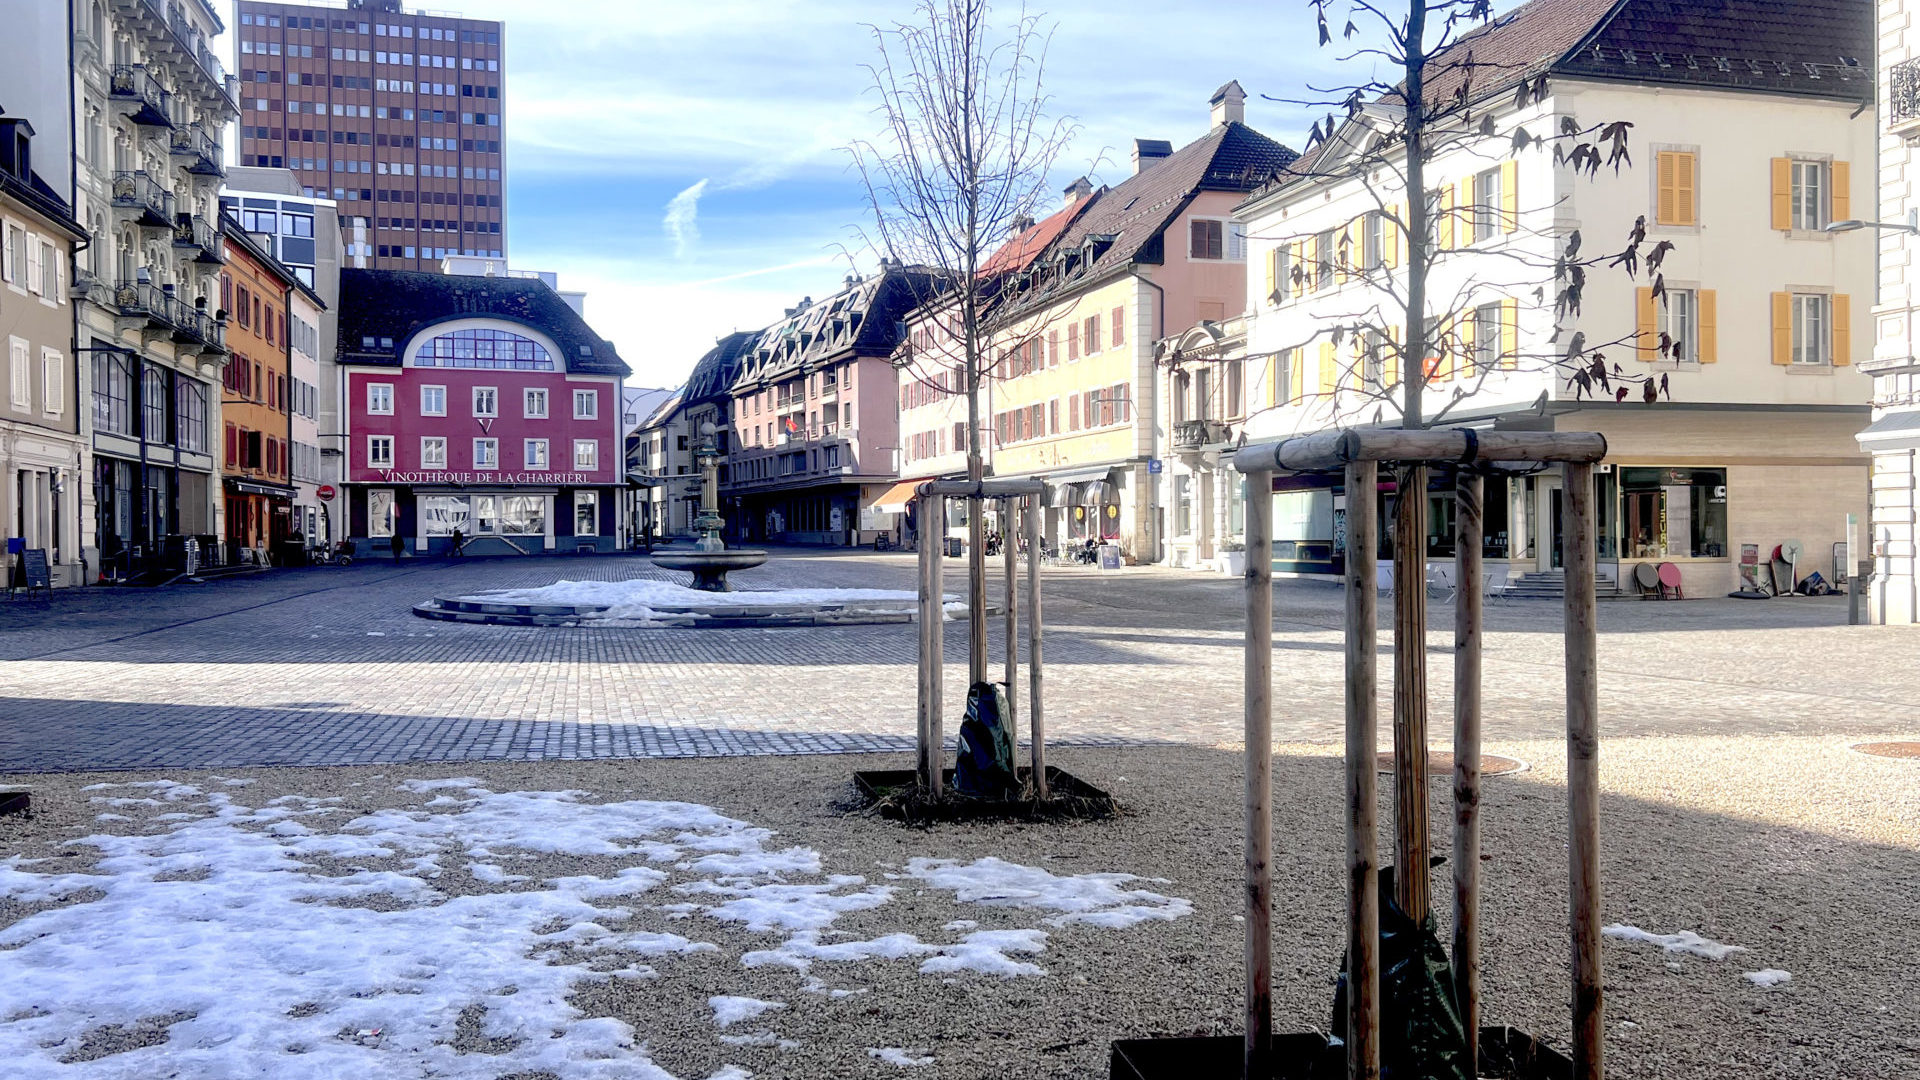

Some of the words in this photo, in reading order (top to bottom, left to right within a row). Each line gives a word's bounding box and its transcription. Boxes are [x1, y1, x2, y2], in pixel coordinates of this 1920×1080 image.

[477, 419, 493, 434] V
[378, 469, 472, 483] VINOTHÈQUE
[477, 472, 494, 483] DE
[498, 472, 514, 483] LA
